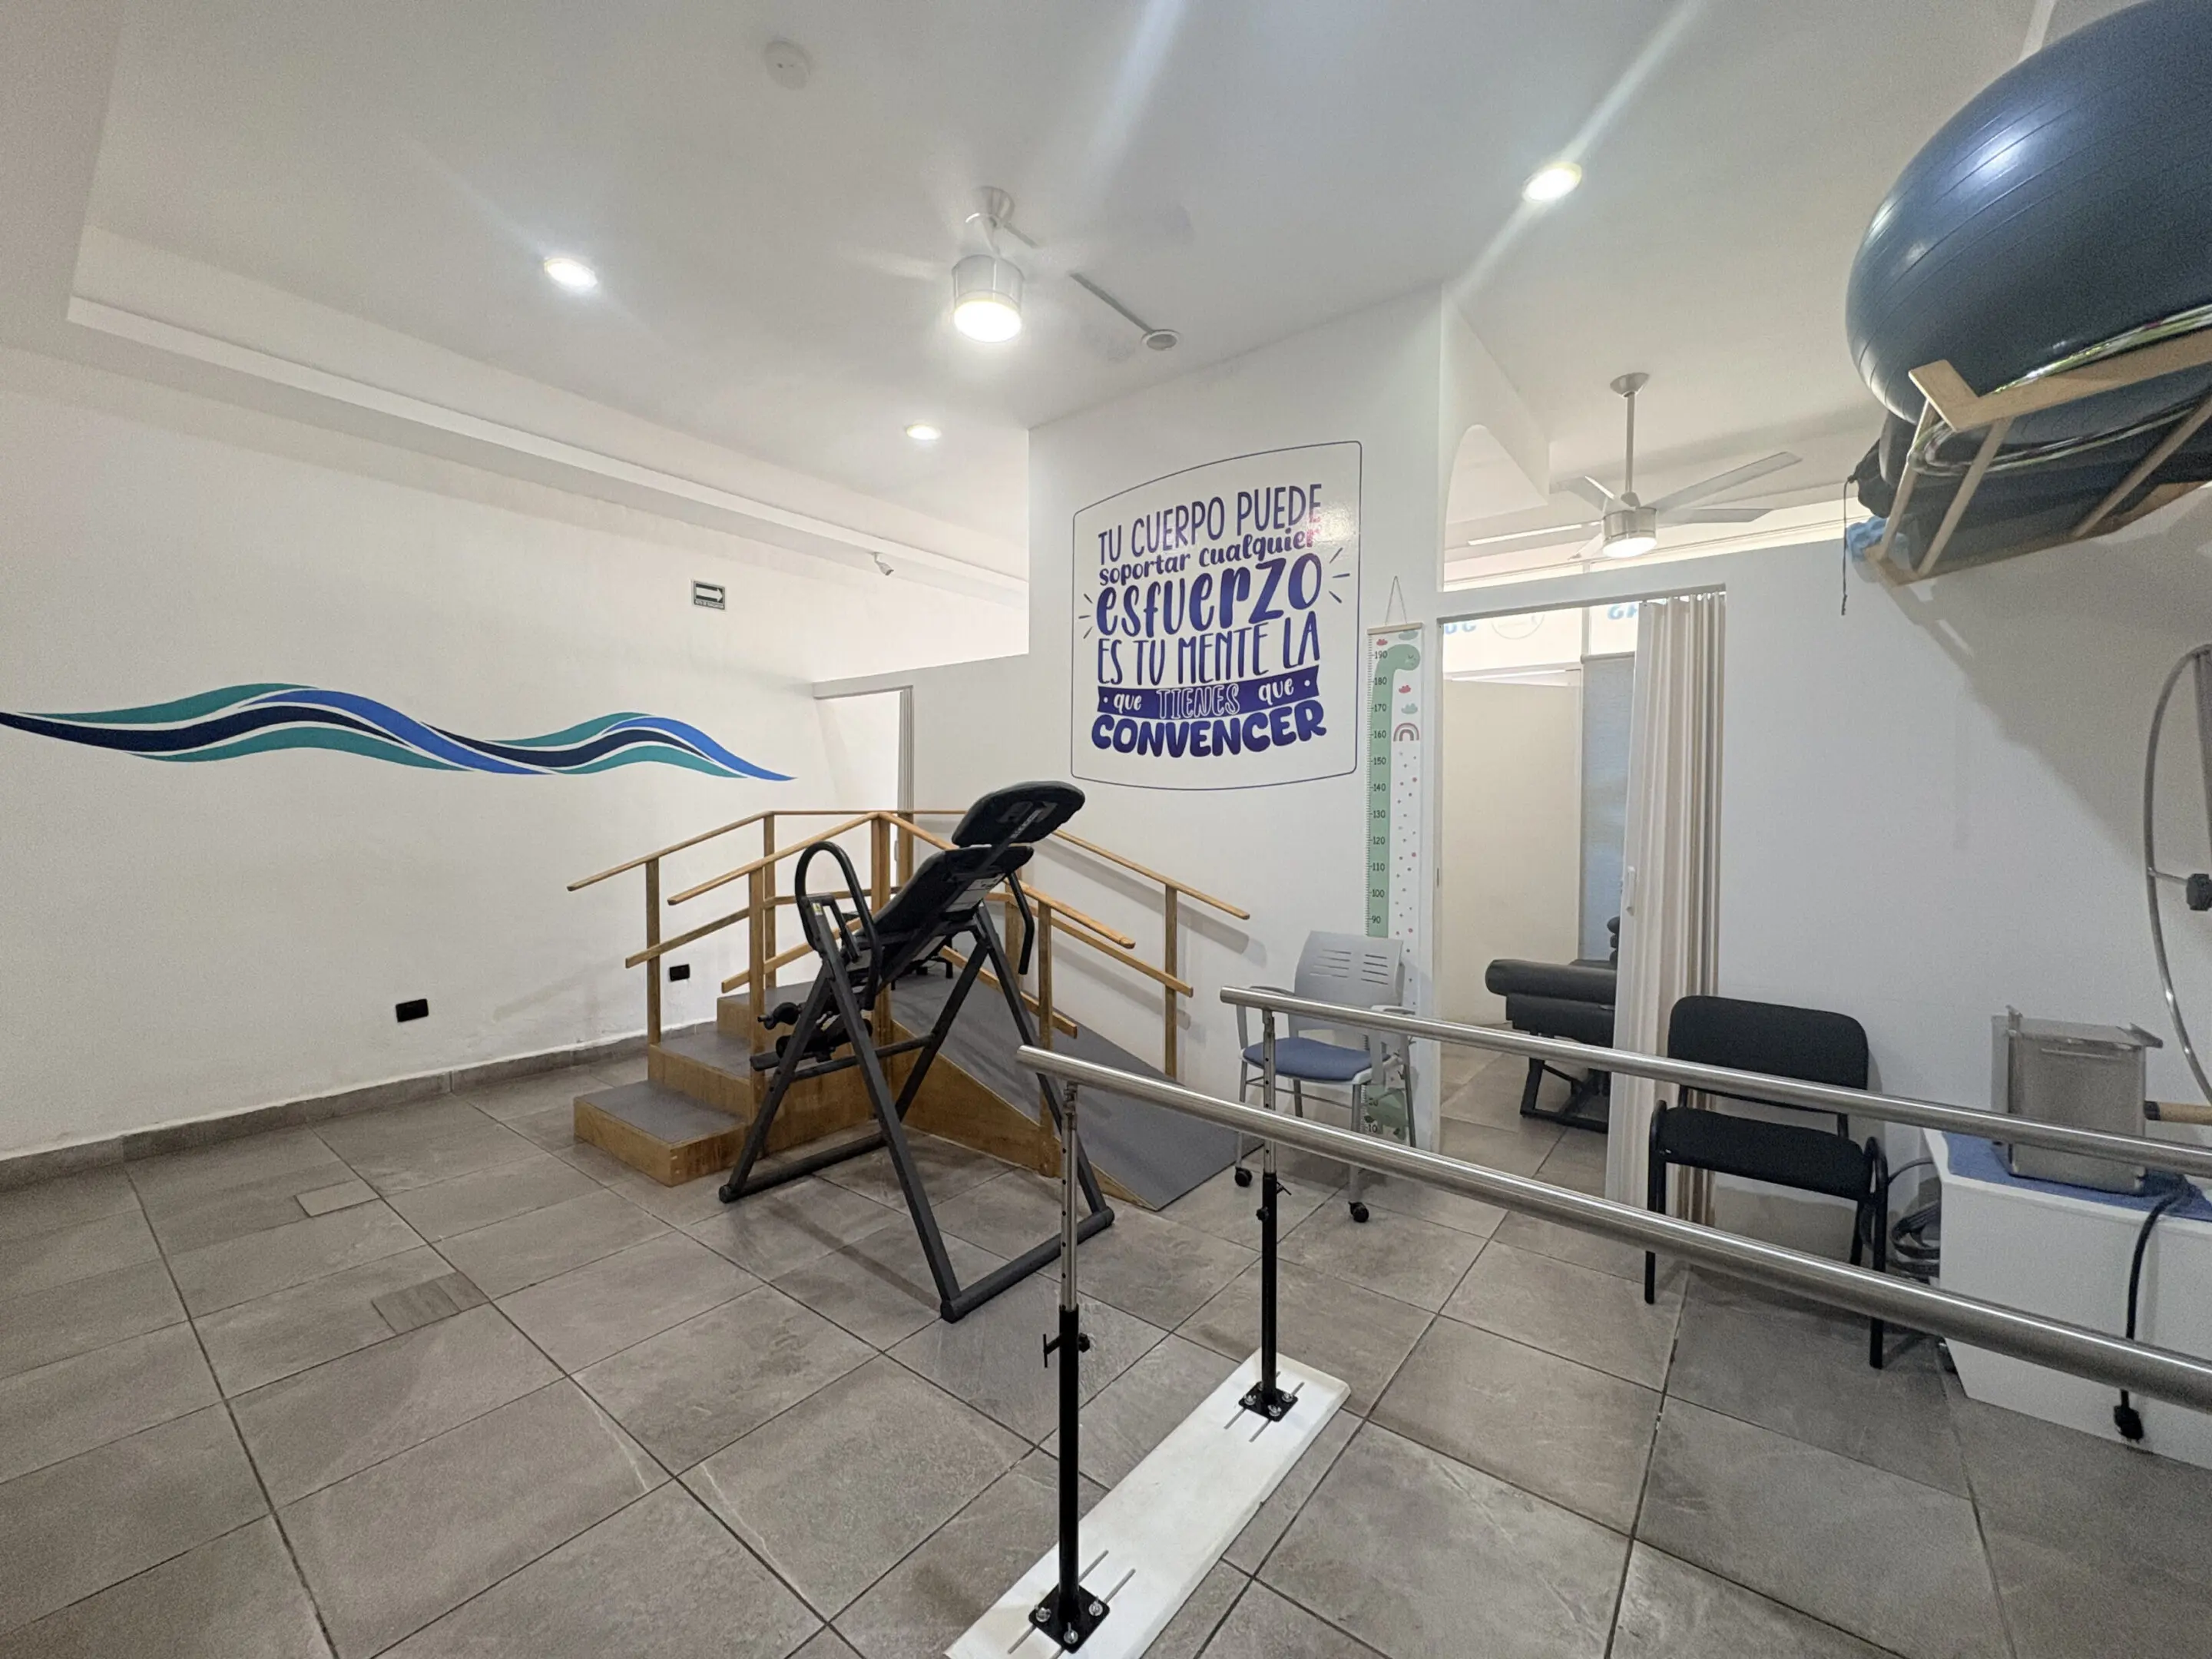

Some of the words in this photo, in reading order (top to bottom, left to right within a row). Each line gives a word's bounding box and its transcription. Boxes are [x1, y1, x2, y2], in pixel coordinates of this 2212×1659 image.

[1098, 525, 1121, 565] TU
[1131, 497, 1225, 557] CUERPO
[1237, 484, 1322, 536] PUEDE
[1099, 552, 1190, 586] soportar
[1199, 527, 1321, 568] cualquier
[1098, 638, 1123, 685] ES
[1133, 639, 1164, 686] TU
[1178, 622, 1269, 685] MENTE
[1283, 611, 1320, 669] LA
[1375, 651, 1388, 659] 190
[1374, 677, 1387, 685] 180
[1114, 694, 1142, 715] que
[1156, 684, 1240, 719] TIENES
[1258, 678, 1294, 704] que
[1374, 704, 1386, 712] 170
[1091, 699, 1327, 758] CONVENCER
[1373, 730, 1386, 738] 160
[1374, 757, 1386, 765] 150
[1373, 783, 1386, 792] 140
[1373, 810, 1386, 818] 130
[1373, 836, 1386, 845] 120
[1373, 863, 1386, 871] 110
[1372, 889, 1385, 897] 100
[1372, 916, 1381, 924] 90
[1369, 1124, 1378, 1133] 10
